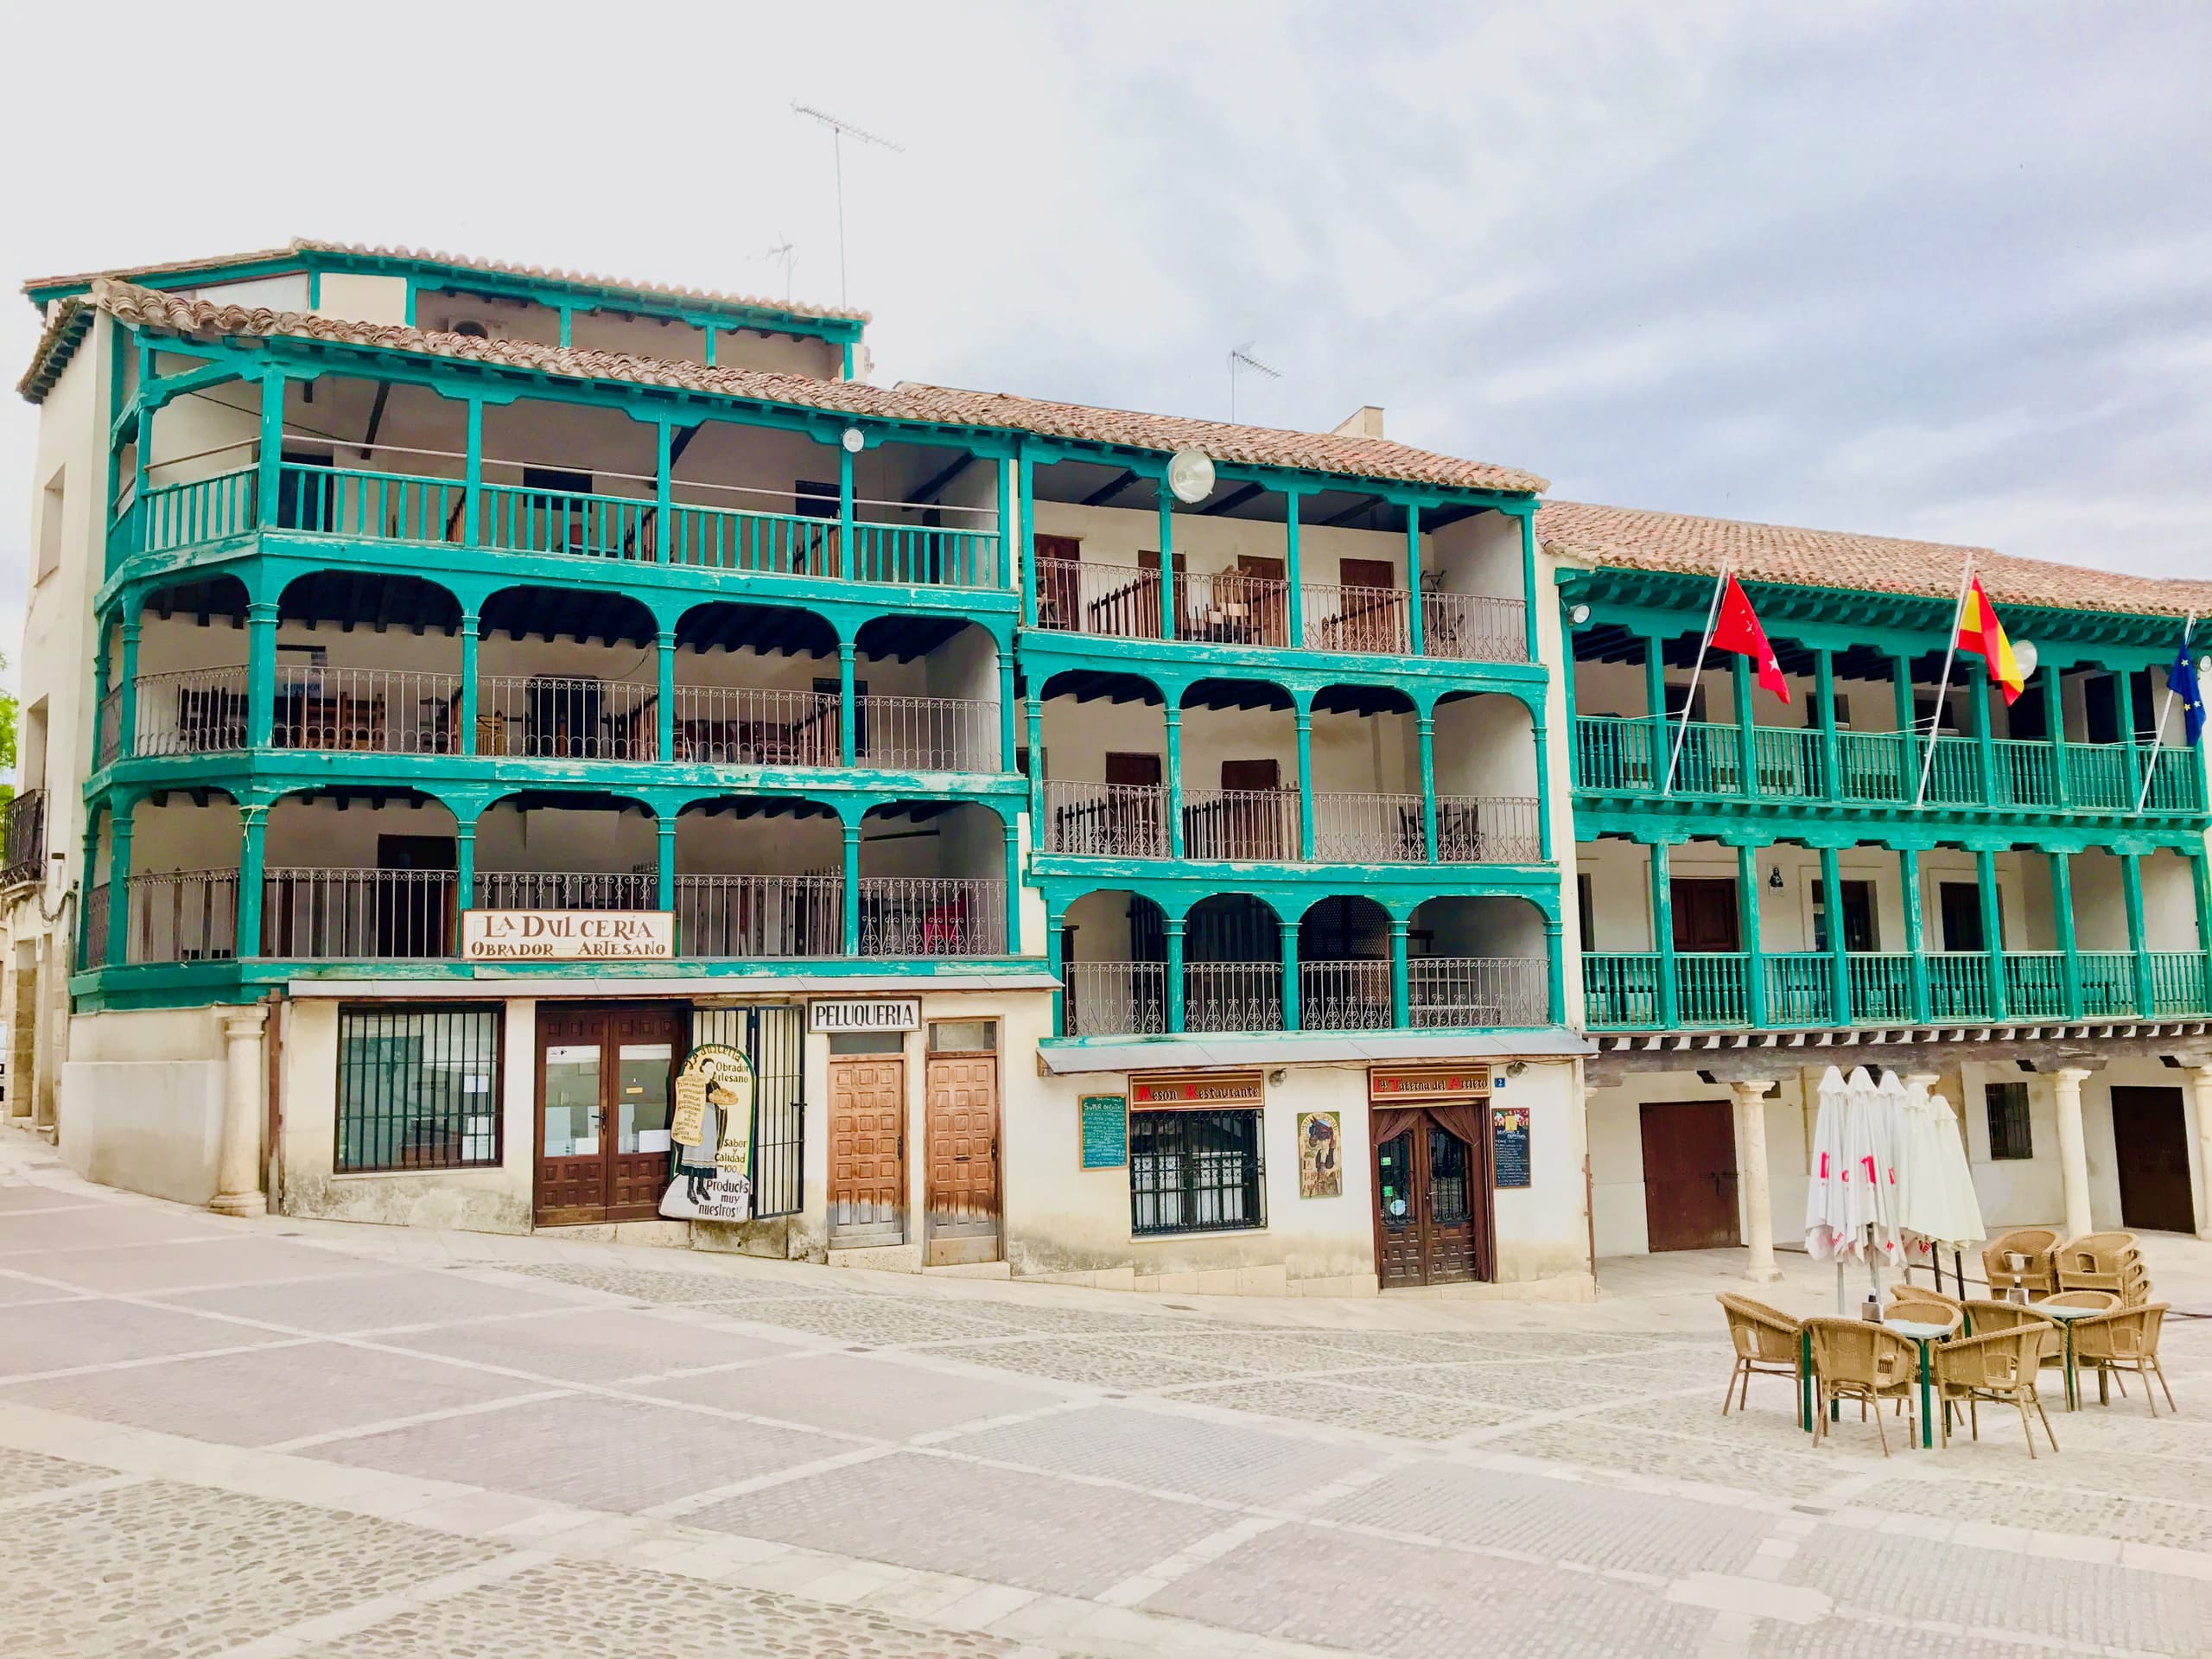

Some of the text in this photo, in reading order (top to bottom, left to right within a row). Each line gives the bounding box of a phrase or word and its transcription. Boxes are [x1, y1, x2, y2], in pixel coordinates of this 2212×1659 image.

[483, 914, 654, 940] LA DULCERÍA
[471, 940, 666, 957] OBRADOR ARTESANO
[815, 1003, 915, 1027] PELUQUERIA
[715, 1061, 749, 1072] Obrador
[1185, 1083, 1260, 1100] Restaurante
[1389, 1077, 1431, 1093] Taberna
[1433, 1080, 1446, 1091] del
[1447, 1076, 1488, 1090] Arriero
